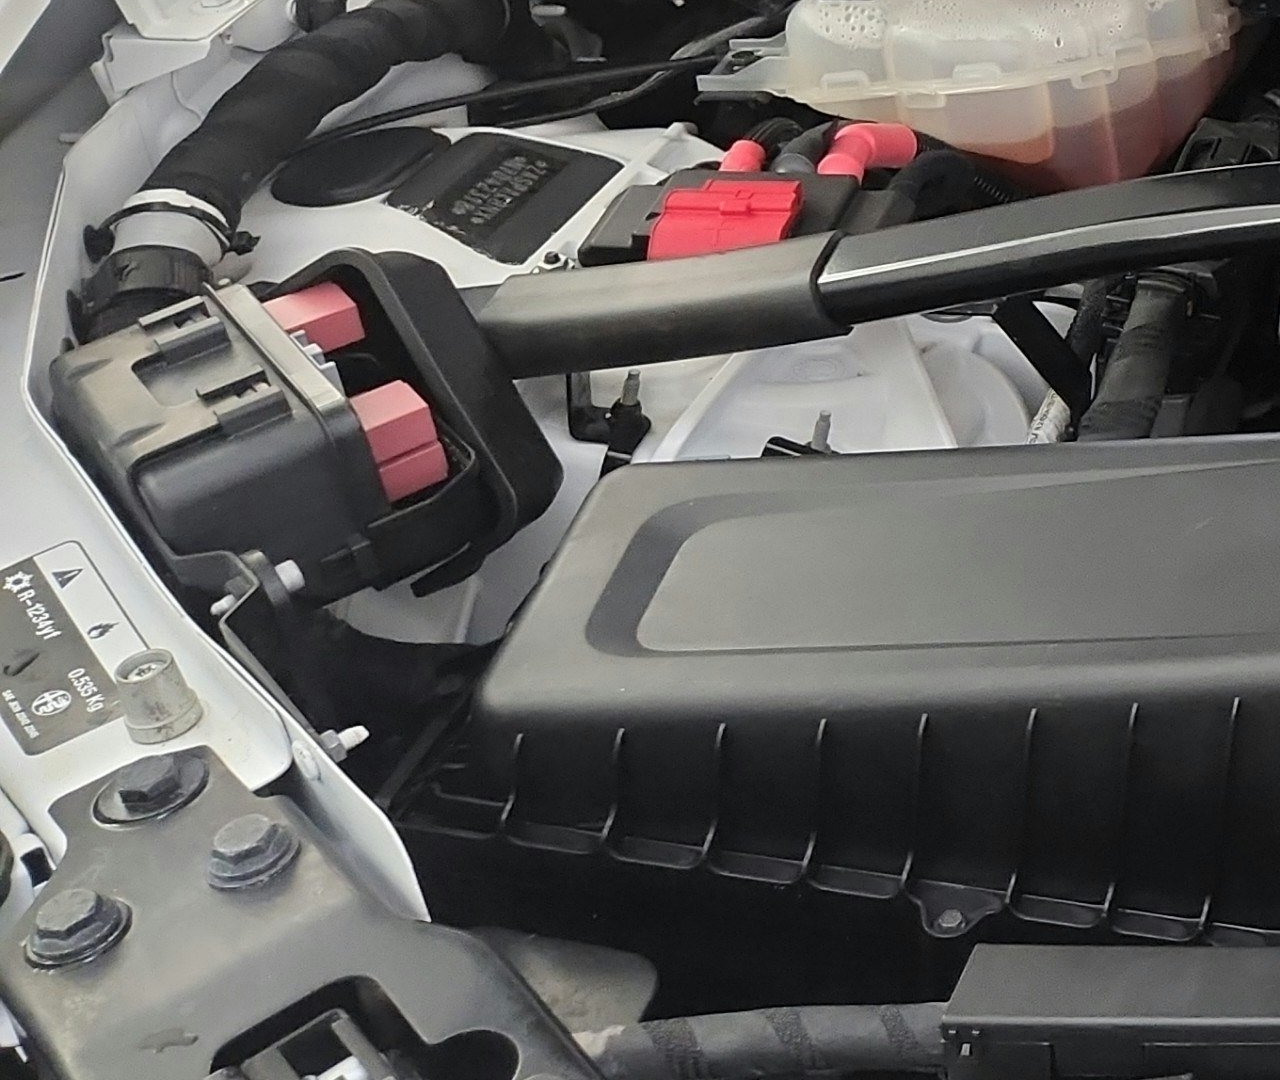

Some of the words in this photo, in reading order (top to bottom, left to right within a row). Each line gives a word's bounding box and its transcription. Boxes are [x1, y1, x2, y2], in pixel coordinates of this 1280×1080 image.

[17, 588, 62, 640] R-1234yf
[67, 667, 99, 699] 0.535
[86, 693, 105, 713] Kg
